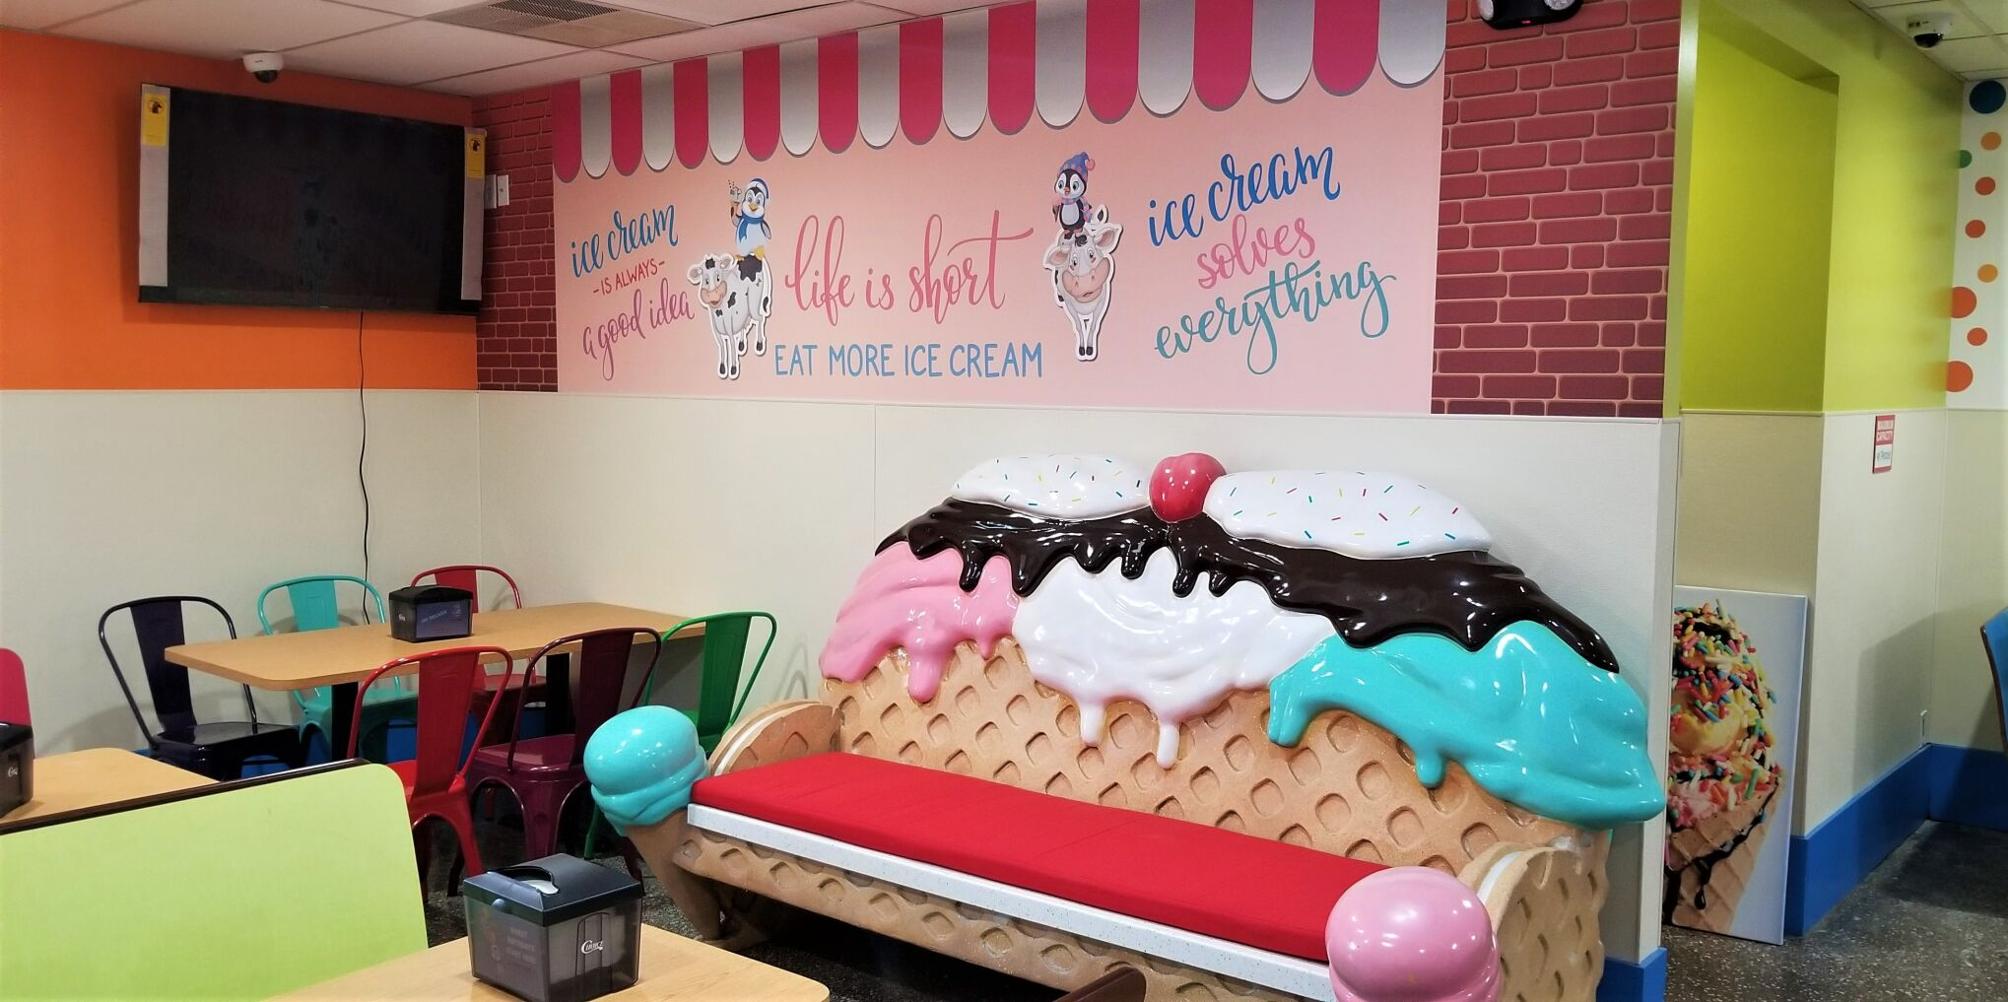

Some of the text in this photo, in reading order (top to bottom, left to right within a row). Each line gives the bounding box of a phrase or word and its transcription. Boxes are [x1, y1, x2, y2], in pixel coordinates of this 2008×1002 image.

[571, 204, 679, 278] ice cream
[1148, 146, 1341, 247] ice cream
[785, 209, 1034, 326] life is short
[1197, 213, 1316, 290] solves
[582, 277, 695, 381] a good idea
[775, 342, 1043, 378] EAT MORE ICE CREAM
[1154, 260, 1397, 375] everything
